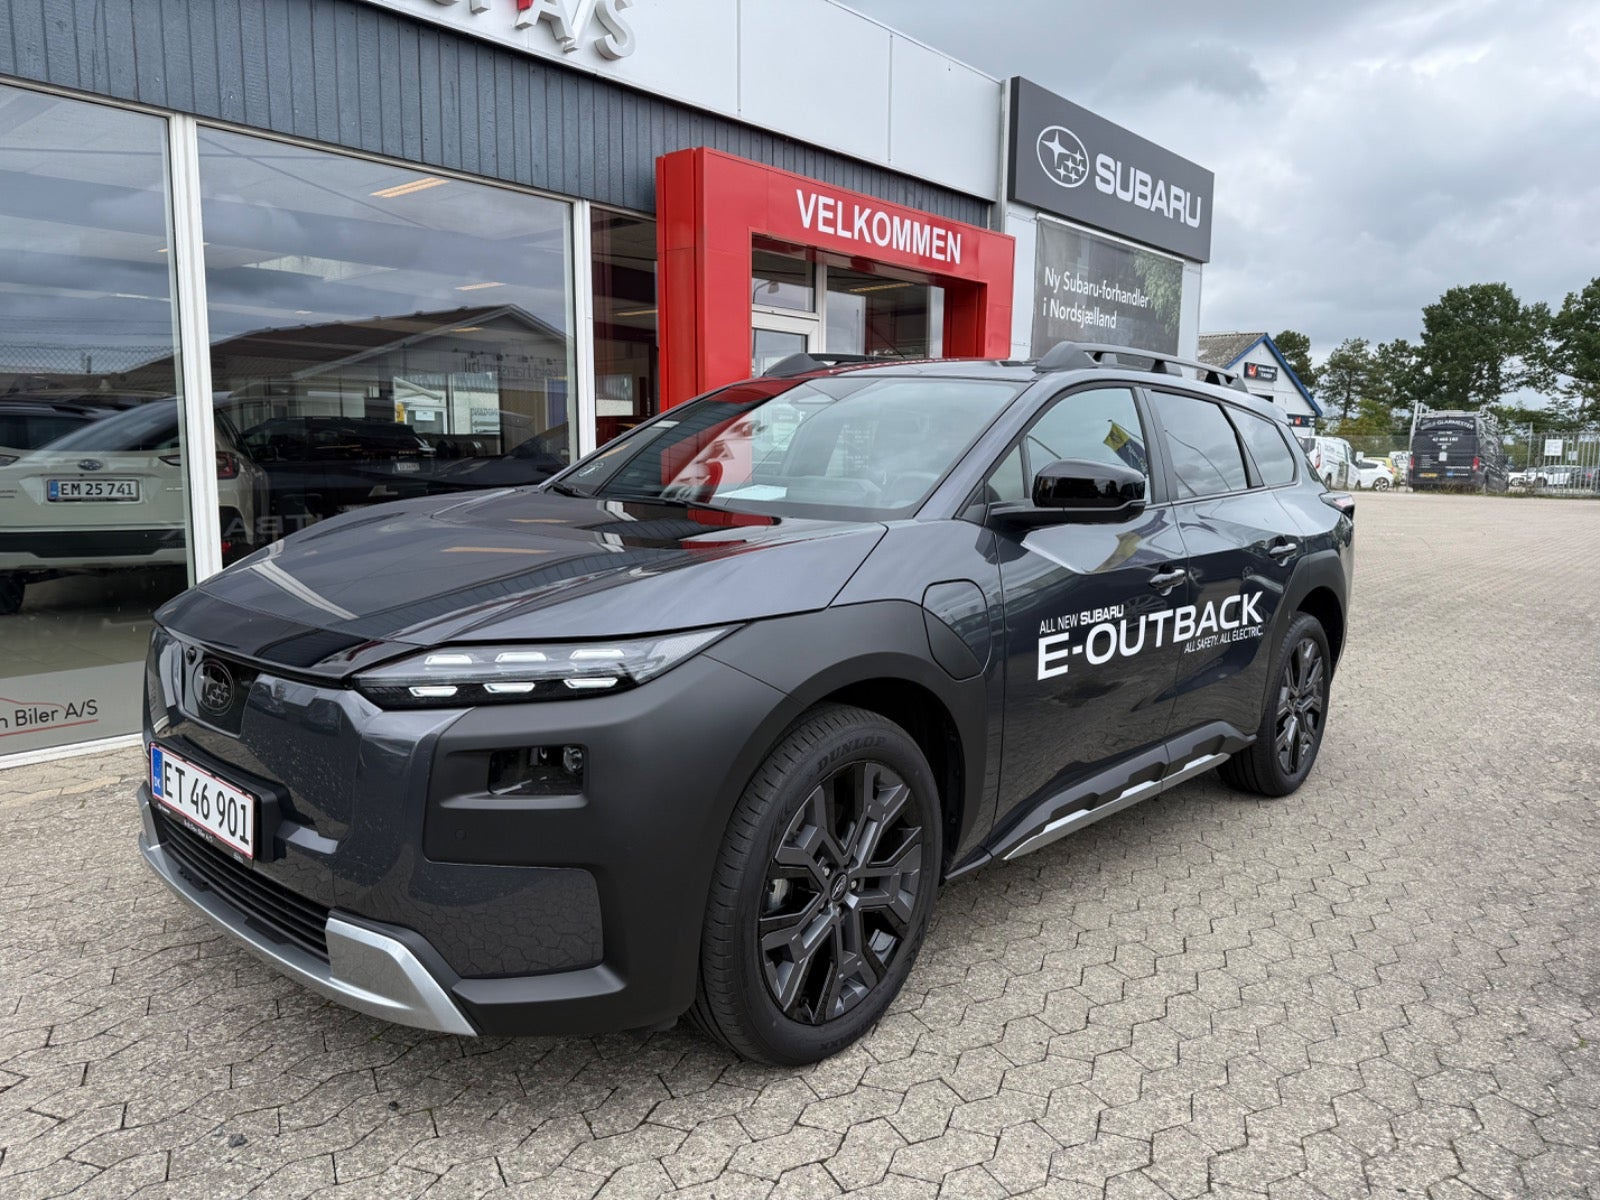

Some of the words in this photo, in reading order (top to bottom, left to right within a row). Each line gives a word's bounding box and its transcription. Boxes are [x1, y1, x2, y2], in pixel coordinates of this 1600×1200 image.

[1094, 153, 1201, 229] SUBARU
[796, 188, 962, 265] VELKOMMEN
[1044, 266, 1061, 293] Ny
[1063, 271, 1149, 308] Subaru-forhandler
[1042, 297, 1047, 317] i
[1050, 298, 1117, 329] Nordsjælland
[60, 483, 81, 496] EM
[86, 483, 103, 496] 25
[108, 483, 134, 496] 741
[1037, 591, 1264, 681] E-OUTBACK
[1039, 618, 1056, 634] ALL
[1058, 613, 1078, 631] NEW
[1080, 604, 1124, 626] SUBARU
[1184, 641, 1196, 654] ALL
[1196, 634, 1220, 651] SAFETY.
[1220, 630, 1231, 644] ALL
[15, 707, 59, 727] Biler
[64, 699, 98, 720] A/S
[816, 735, 887, 776] DUNLOP
[164, 760, 186, 804] ET
[190, 777, 210, 820] 46
[216, 790, 249, 846] 901
